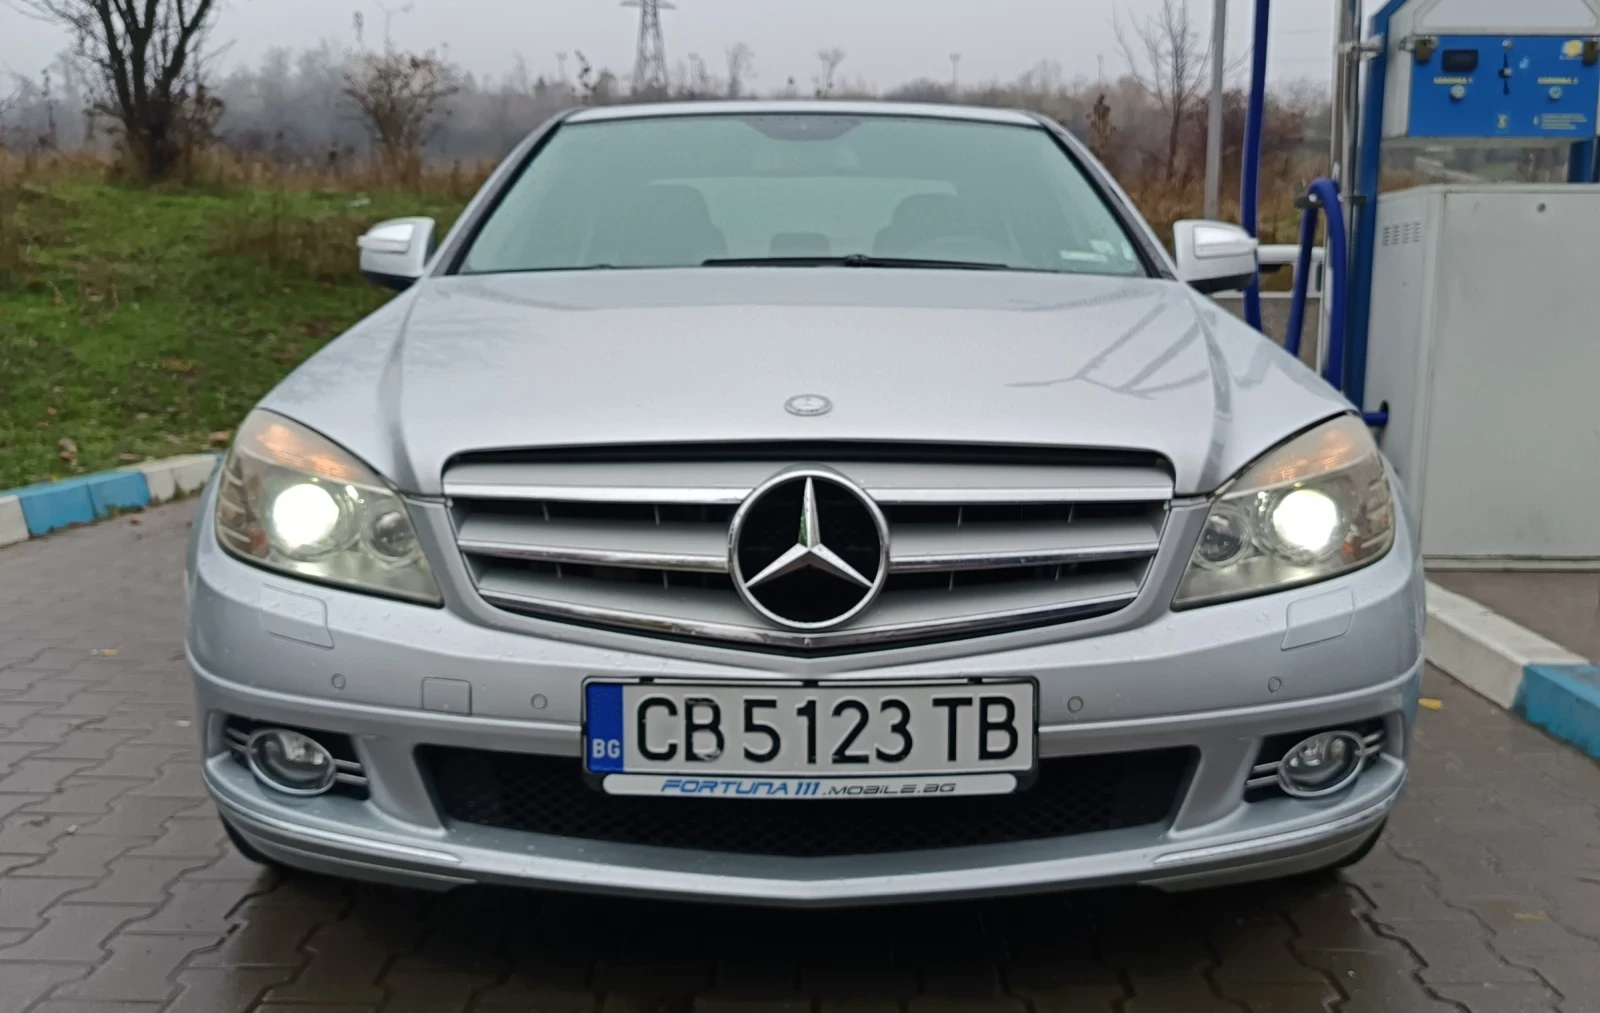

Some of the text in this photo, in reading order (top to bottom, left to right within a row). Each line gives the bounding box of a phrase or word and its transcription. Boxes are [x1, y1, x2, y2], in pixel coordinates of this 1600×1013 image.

[637, 696, 1019, 764] CB 5123 TB
[592, 738, 621, 758] BG
[661, 779, 788, 795] FORTUNA
